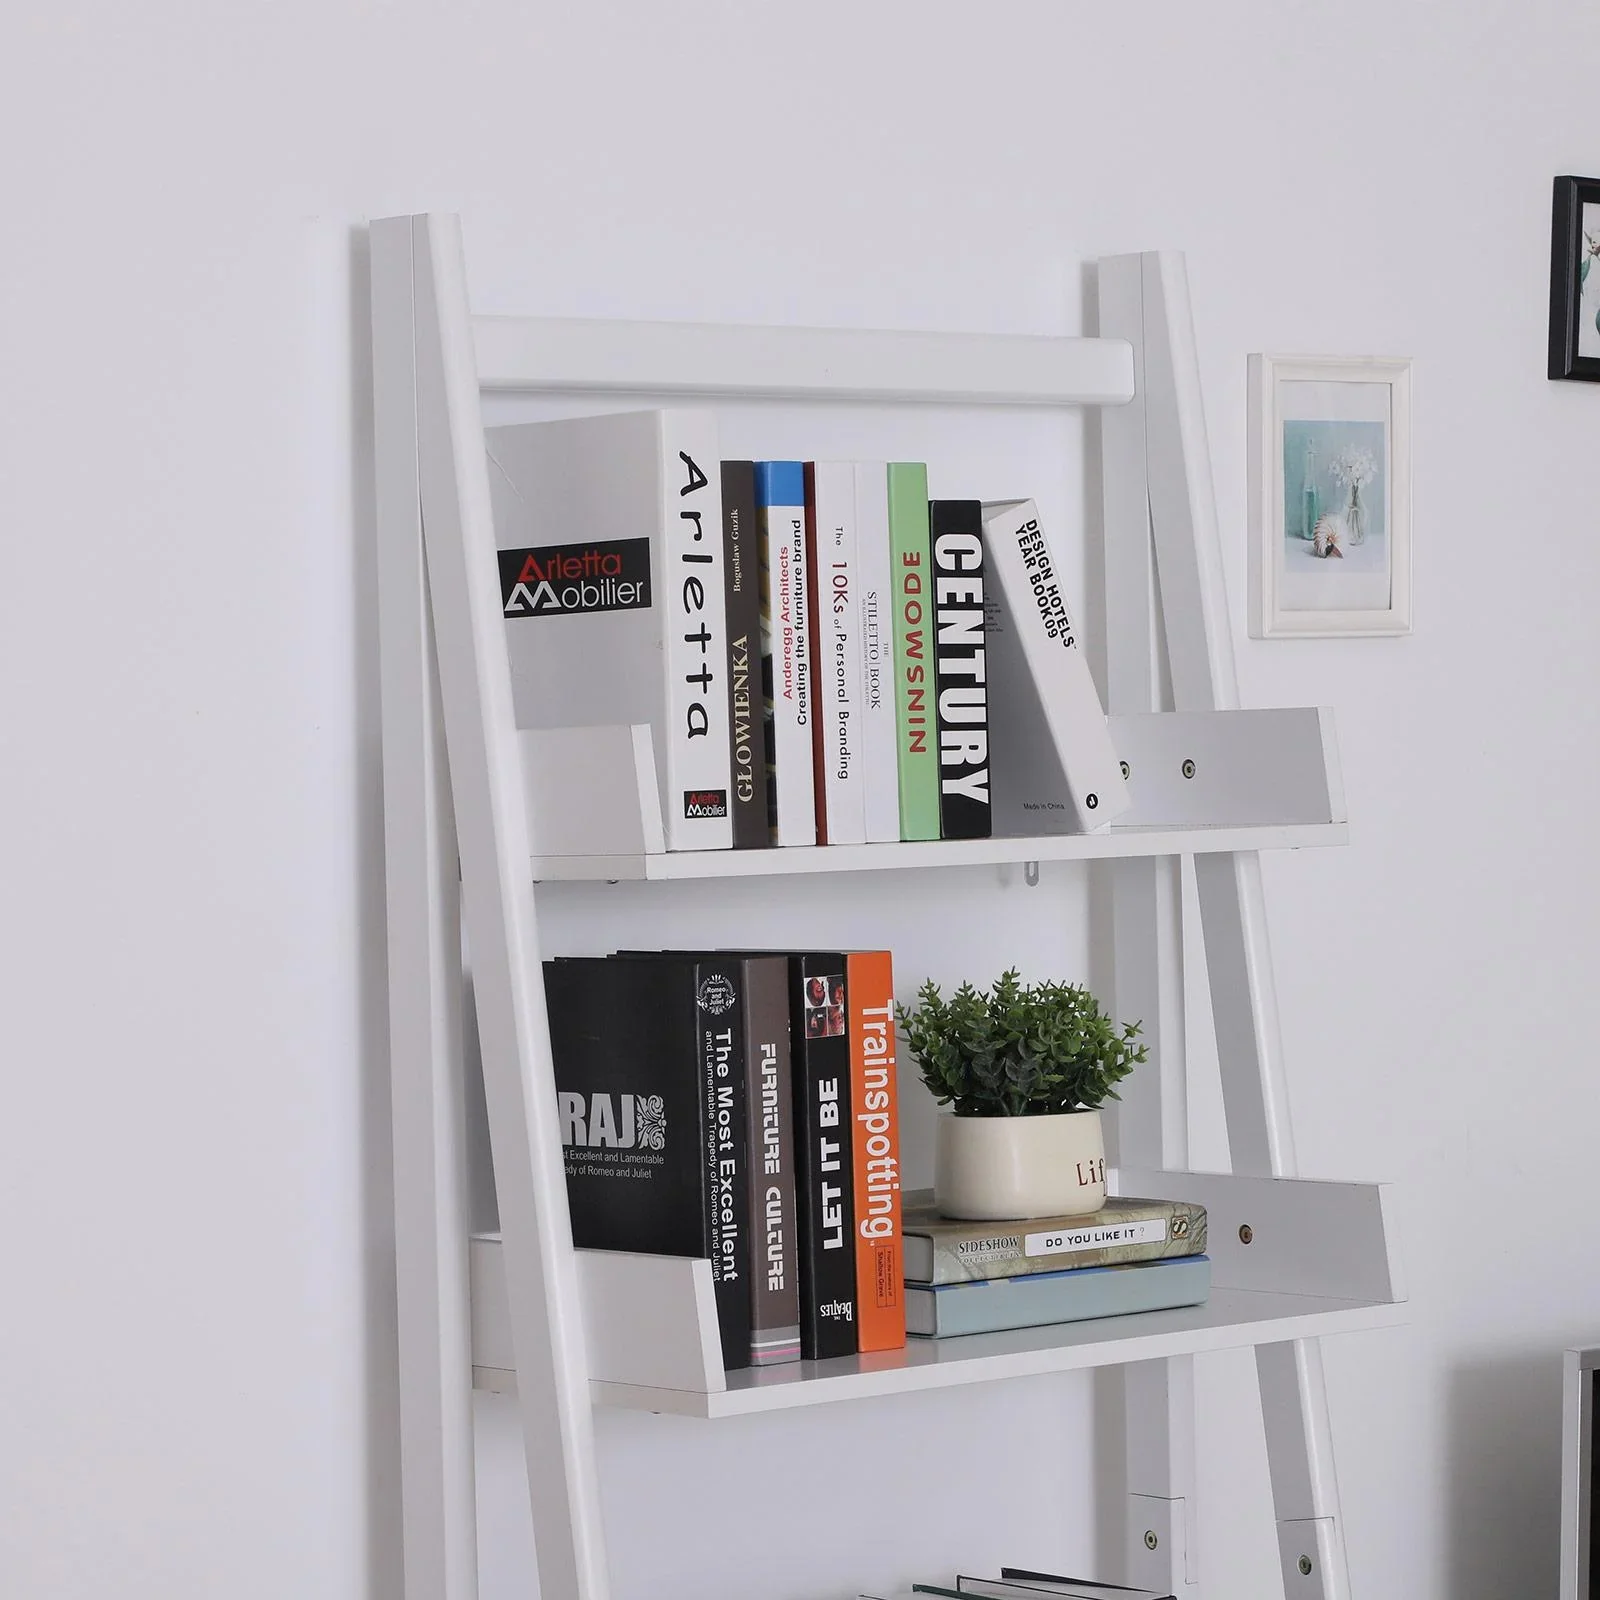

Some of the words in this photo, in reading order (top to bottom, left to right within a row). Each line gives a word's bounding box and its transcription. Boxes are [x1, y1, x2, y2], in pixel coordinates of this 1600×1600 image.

[730, 508, 739, 541] Guzik
[791, 520, 801, 562] brand
[835, 527, 844, 546] The
[517, 550, 622, 582] Arletta
[779, 546, 790, 622] Architects
[832, 562, 849, 613] 10Ks
[1015, 524, 1037, 570] YEAR
[1029, 573, 1059, 639] BOOK09
[1025, 519, 1054, 581] DESIGN
[1046, 584, 1075, 649] HOTELS
[503, 577, 644, 612] Mobilier
[679, 450, 713, 739] Arletta
[793, 566, 804, 631] furniture
[794, 635, 805, 659] the
[833, 619, 842, 629] of
[867, 591, 879, 660] STILETTO
[782, 627, 793, 700] Anderegg
[835, 633, 849, 703] Personal
[903, 551, 927, 752] NINSMODE
[934, 533, 989, 804] CENTURY
[796, 662, 808, 725] Creating
[870, 669, 880, 709] BOOK
[837, 711, 851, 780] Branding
[705, 1030, 714, 1051] and
[715, 1028, 732, 1078] The
[706, 1054, 715, 1119] Lamentable
[818, 1078, 839, 1127] BE
[558, 1091, 636, 1149] RAJ
[717, 1086, 734, 1152] Most
[857, 999, 899, 1239] Trainspotting
[570, 1150, 603, 1161] Excellent
[604, 1152, 618, 1162] and
[620, 1152, 664, 1164] Lamentable
[708, 1122, 717, 1169] Tragedy
[820, 1137, 841, 1172] IT
[579, 1165, 586, 1175] of
[587, 1165, 615, 1176] Romeo
[616, 1168, 630, 1177] and
[632, 1168, 652, 1179] Juliet
[710, 1171, 718, 1184] of
[711, 1186, 719, 1226] Romeo
[720, 1159, 738, 1282] Excellent
[821, 1182, 843, 1250] LET
[711, 1228, 720, 1249] and
[959, 1237, 1018, 1254] SIDESHOW
[1045, 1236, 1063, 1248] DO
[1067, 1233, 1091, 1245] YOU
[1094, 1230, 1120, 1242] LIKE
[1124, 1228, 1136, 1239] IT
[712, 1252, 721, 1282] Juliet
[819, 1300, 853, 1321] BEATLES
